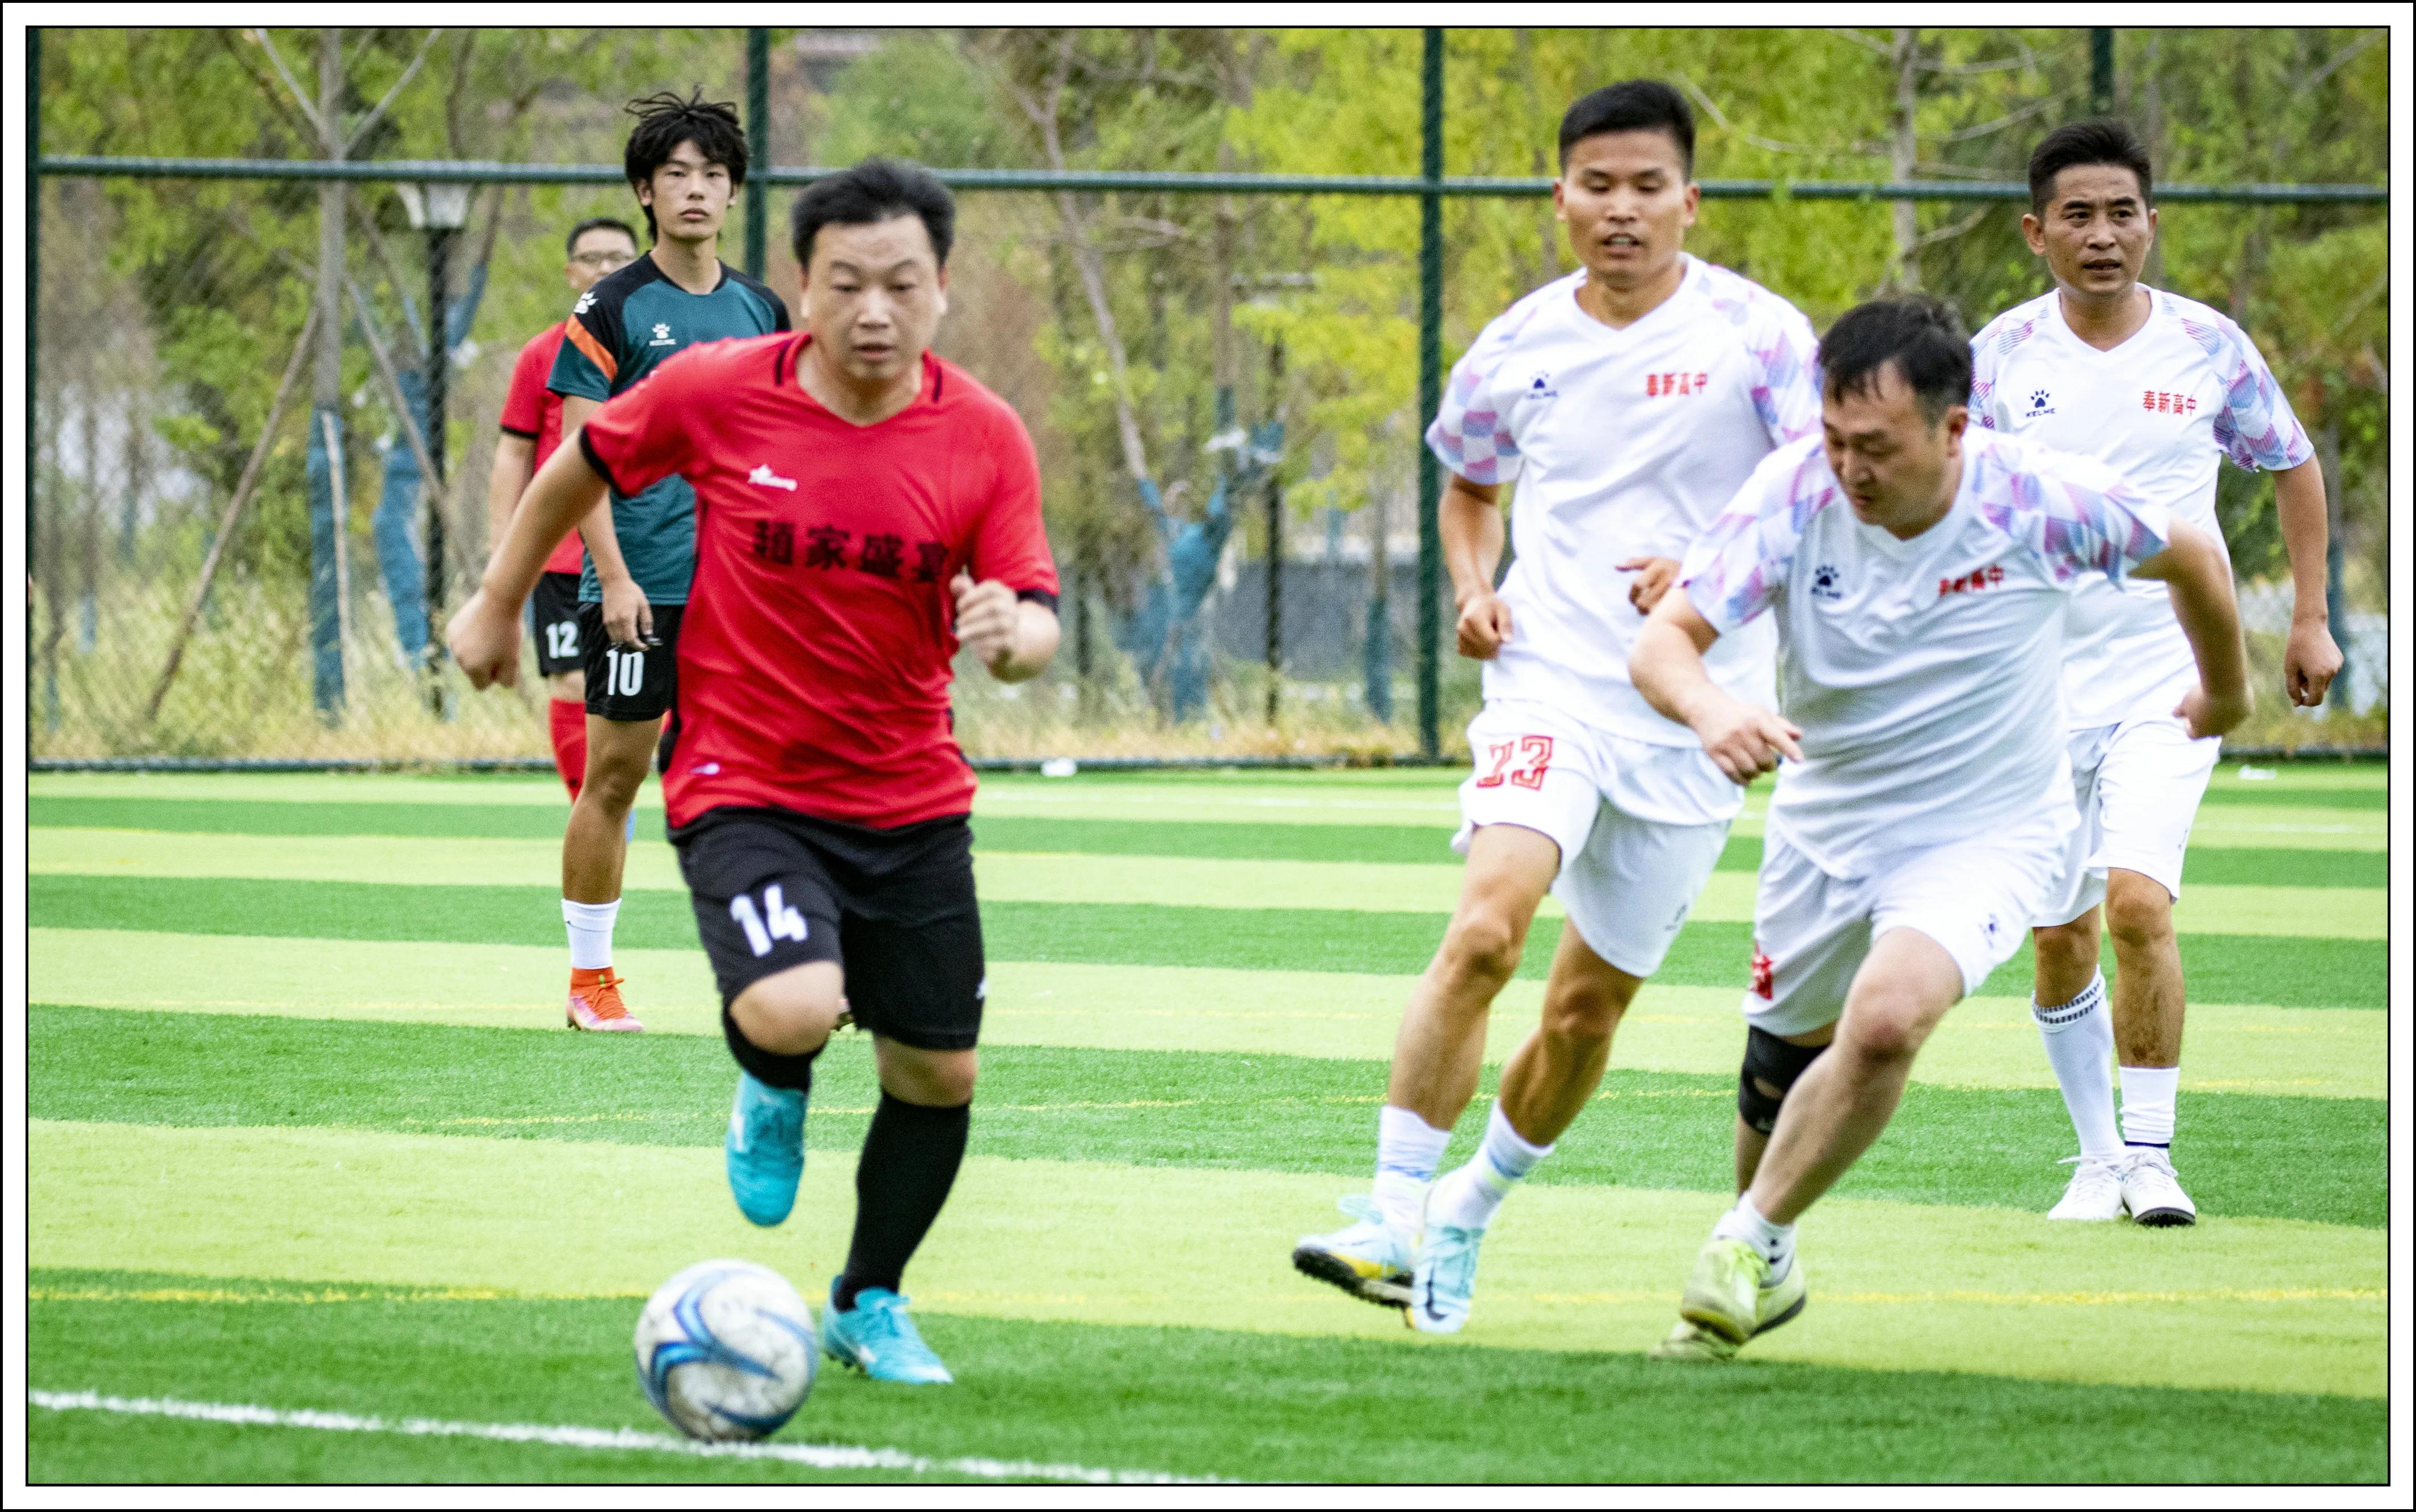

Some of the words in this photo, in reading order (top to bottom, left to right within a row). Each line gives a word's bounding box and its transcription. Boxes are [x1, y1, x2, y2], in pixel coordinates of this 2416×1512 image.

[2142, 390, 2197, 417] 奉新高中
[546, 620, 579, 658] 12
[606, 649, 644, 696] 10
[730, 882, 809, 957] 14
